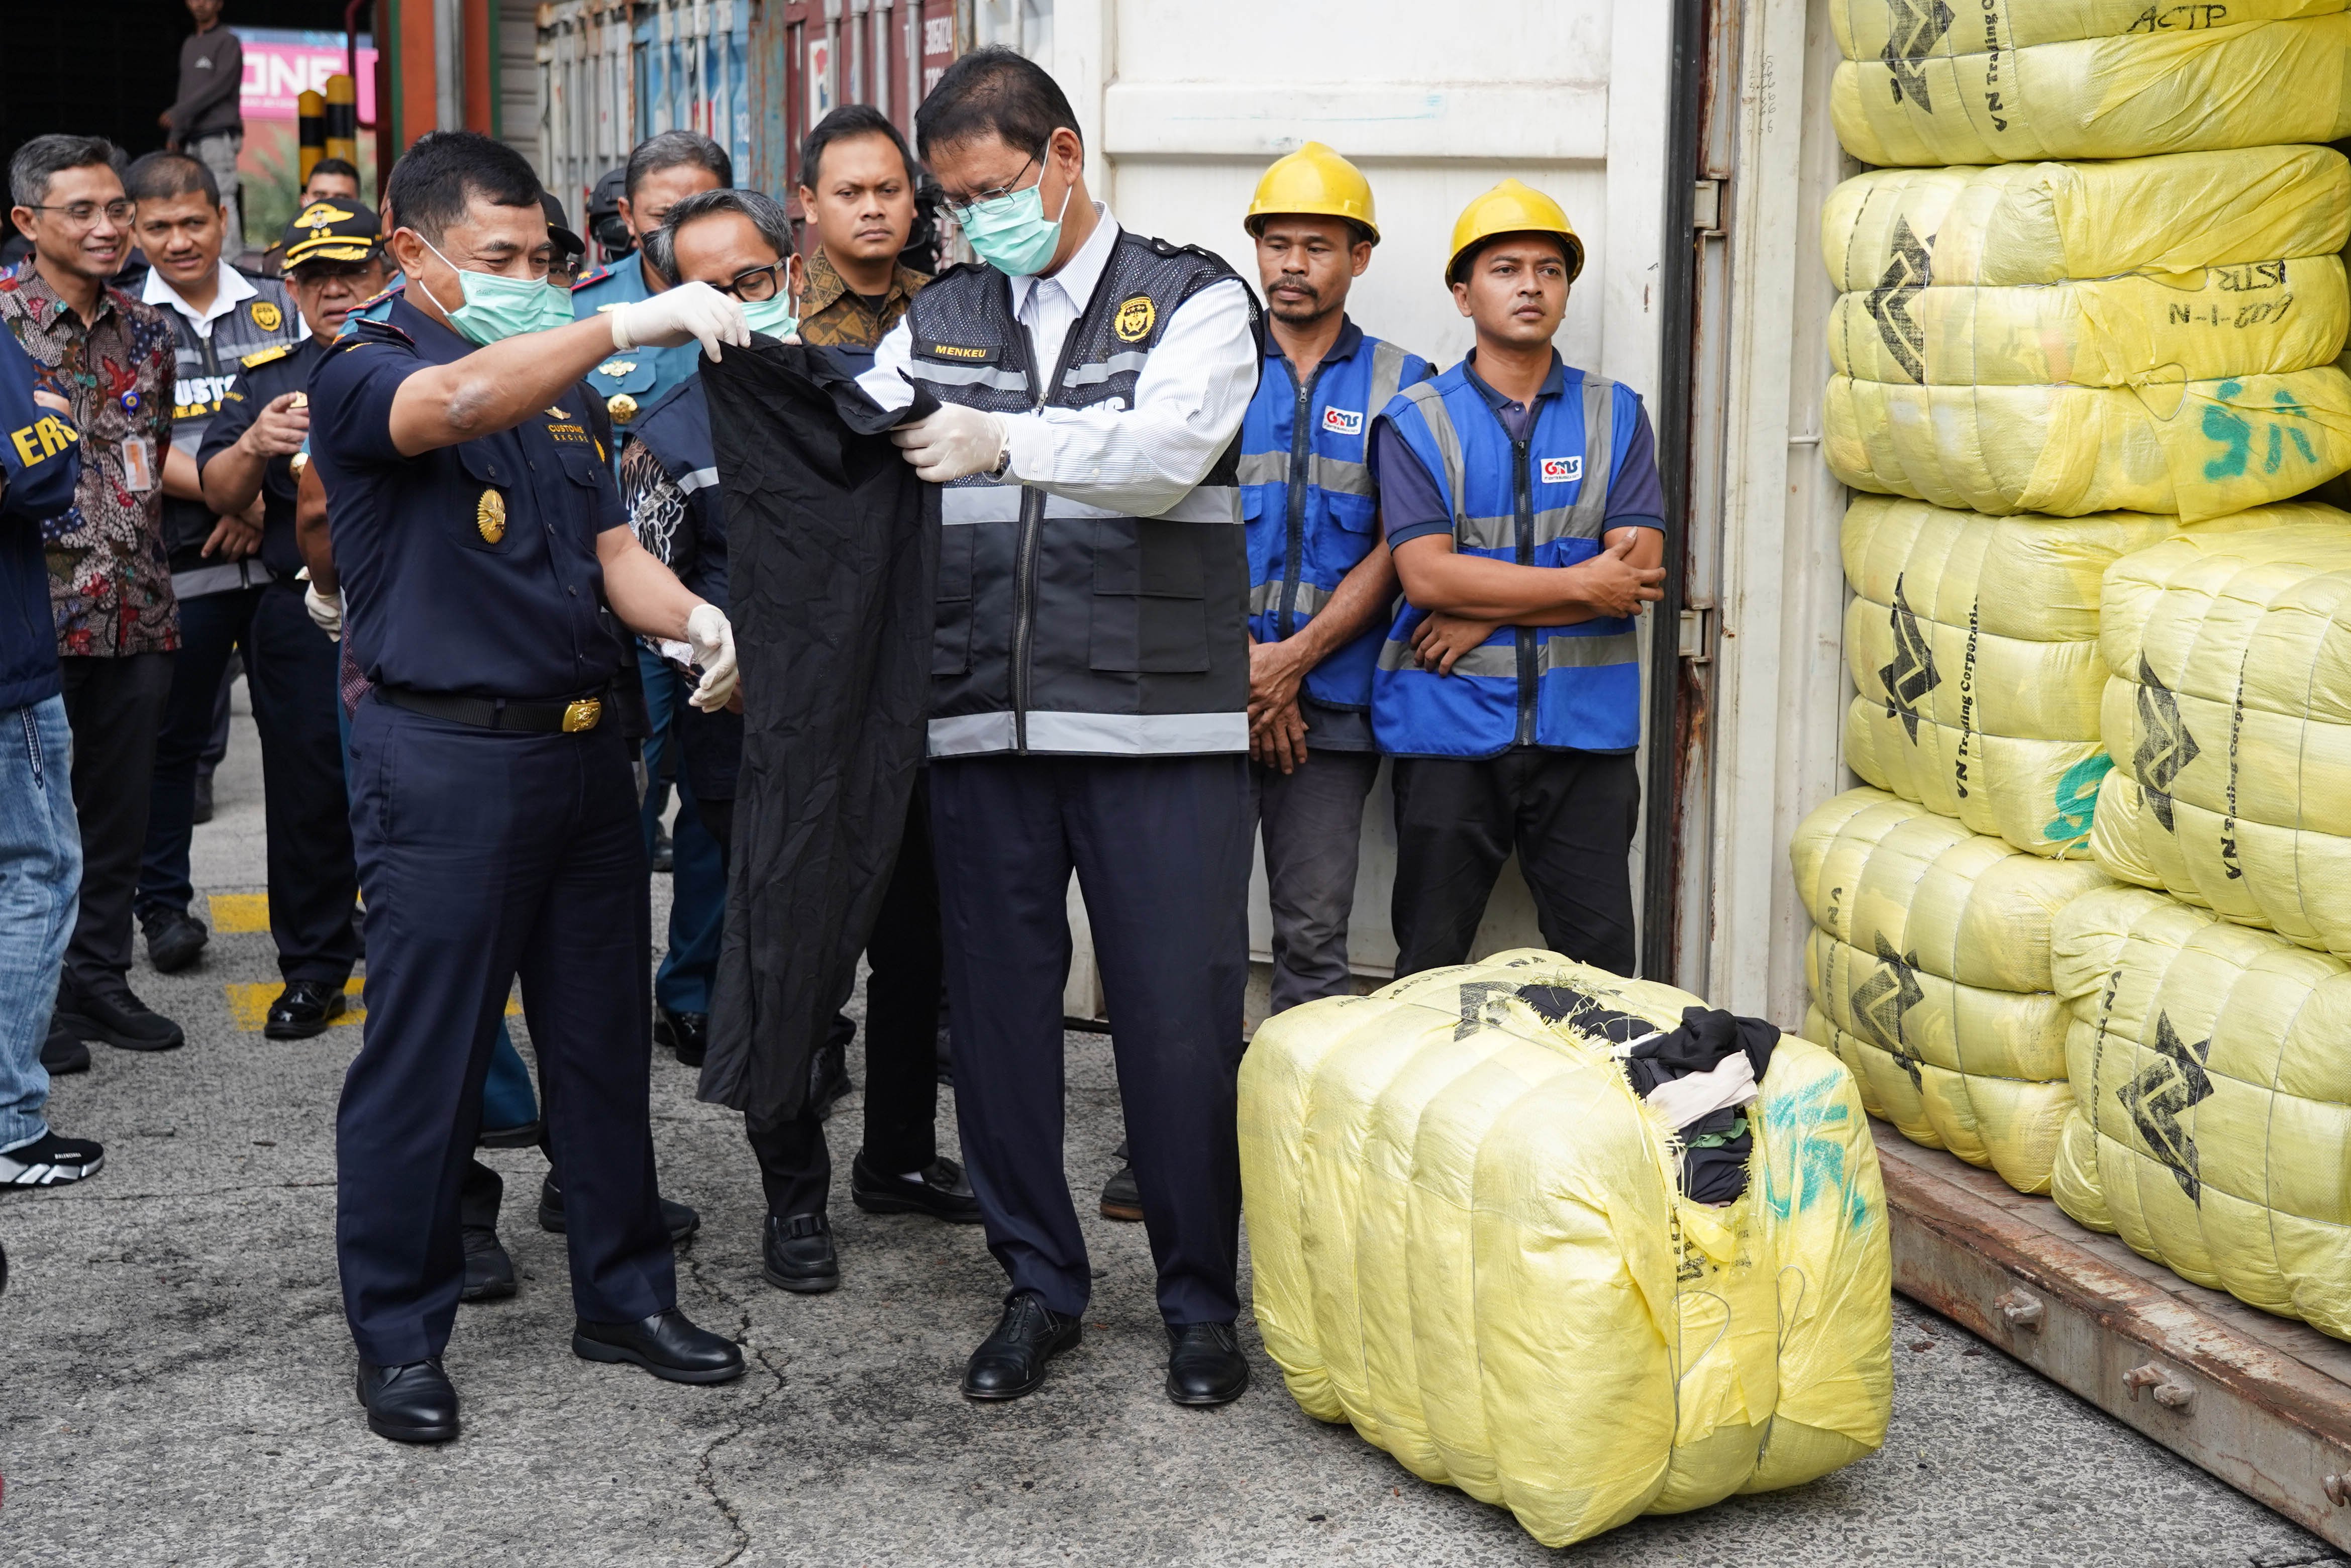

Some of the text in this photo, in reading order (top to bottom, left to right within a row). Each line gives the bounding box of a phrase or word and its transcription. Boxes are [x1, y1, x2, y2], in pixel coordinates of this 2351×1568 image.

[1984, 13, 1999, 85] Trading
[1983, 92, 2007, 132] VN
[935, 345, 986, 358] MENKEU
[548, 425, 584, 434] CUSTOMS
[553, 434, 589, 443] EXCISE
[1958, 696, 1972, 757] Trading
[1955, 759, 1968, 799] VN
[2220, 837, 2242, 880] VN
